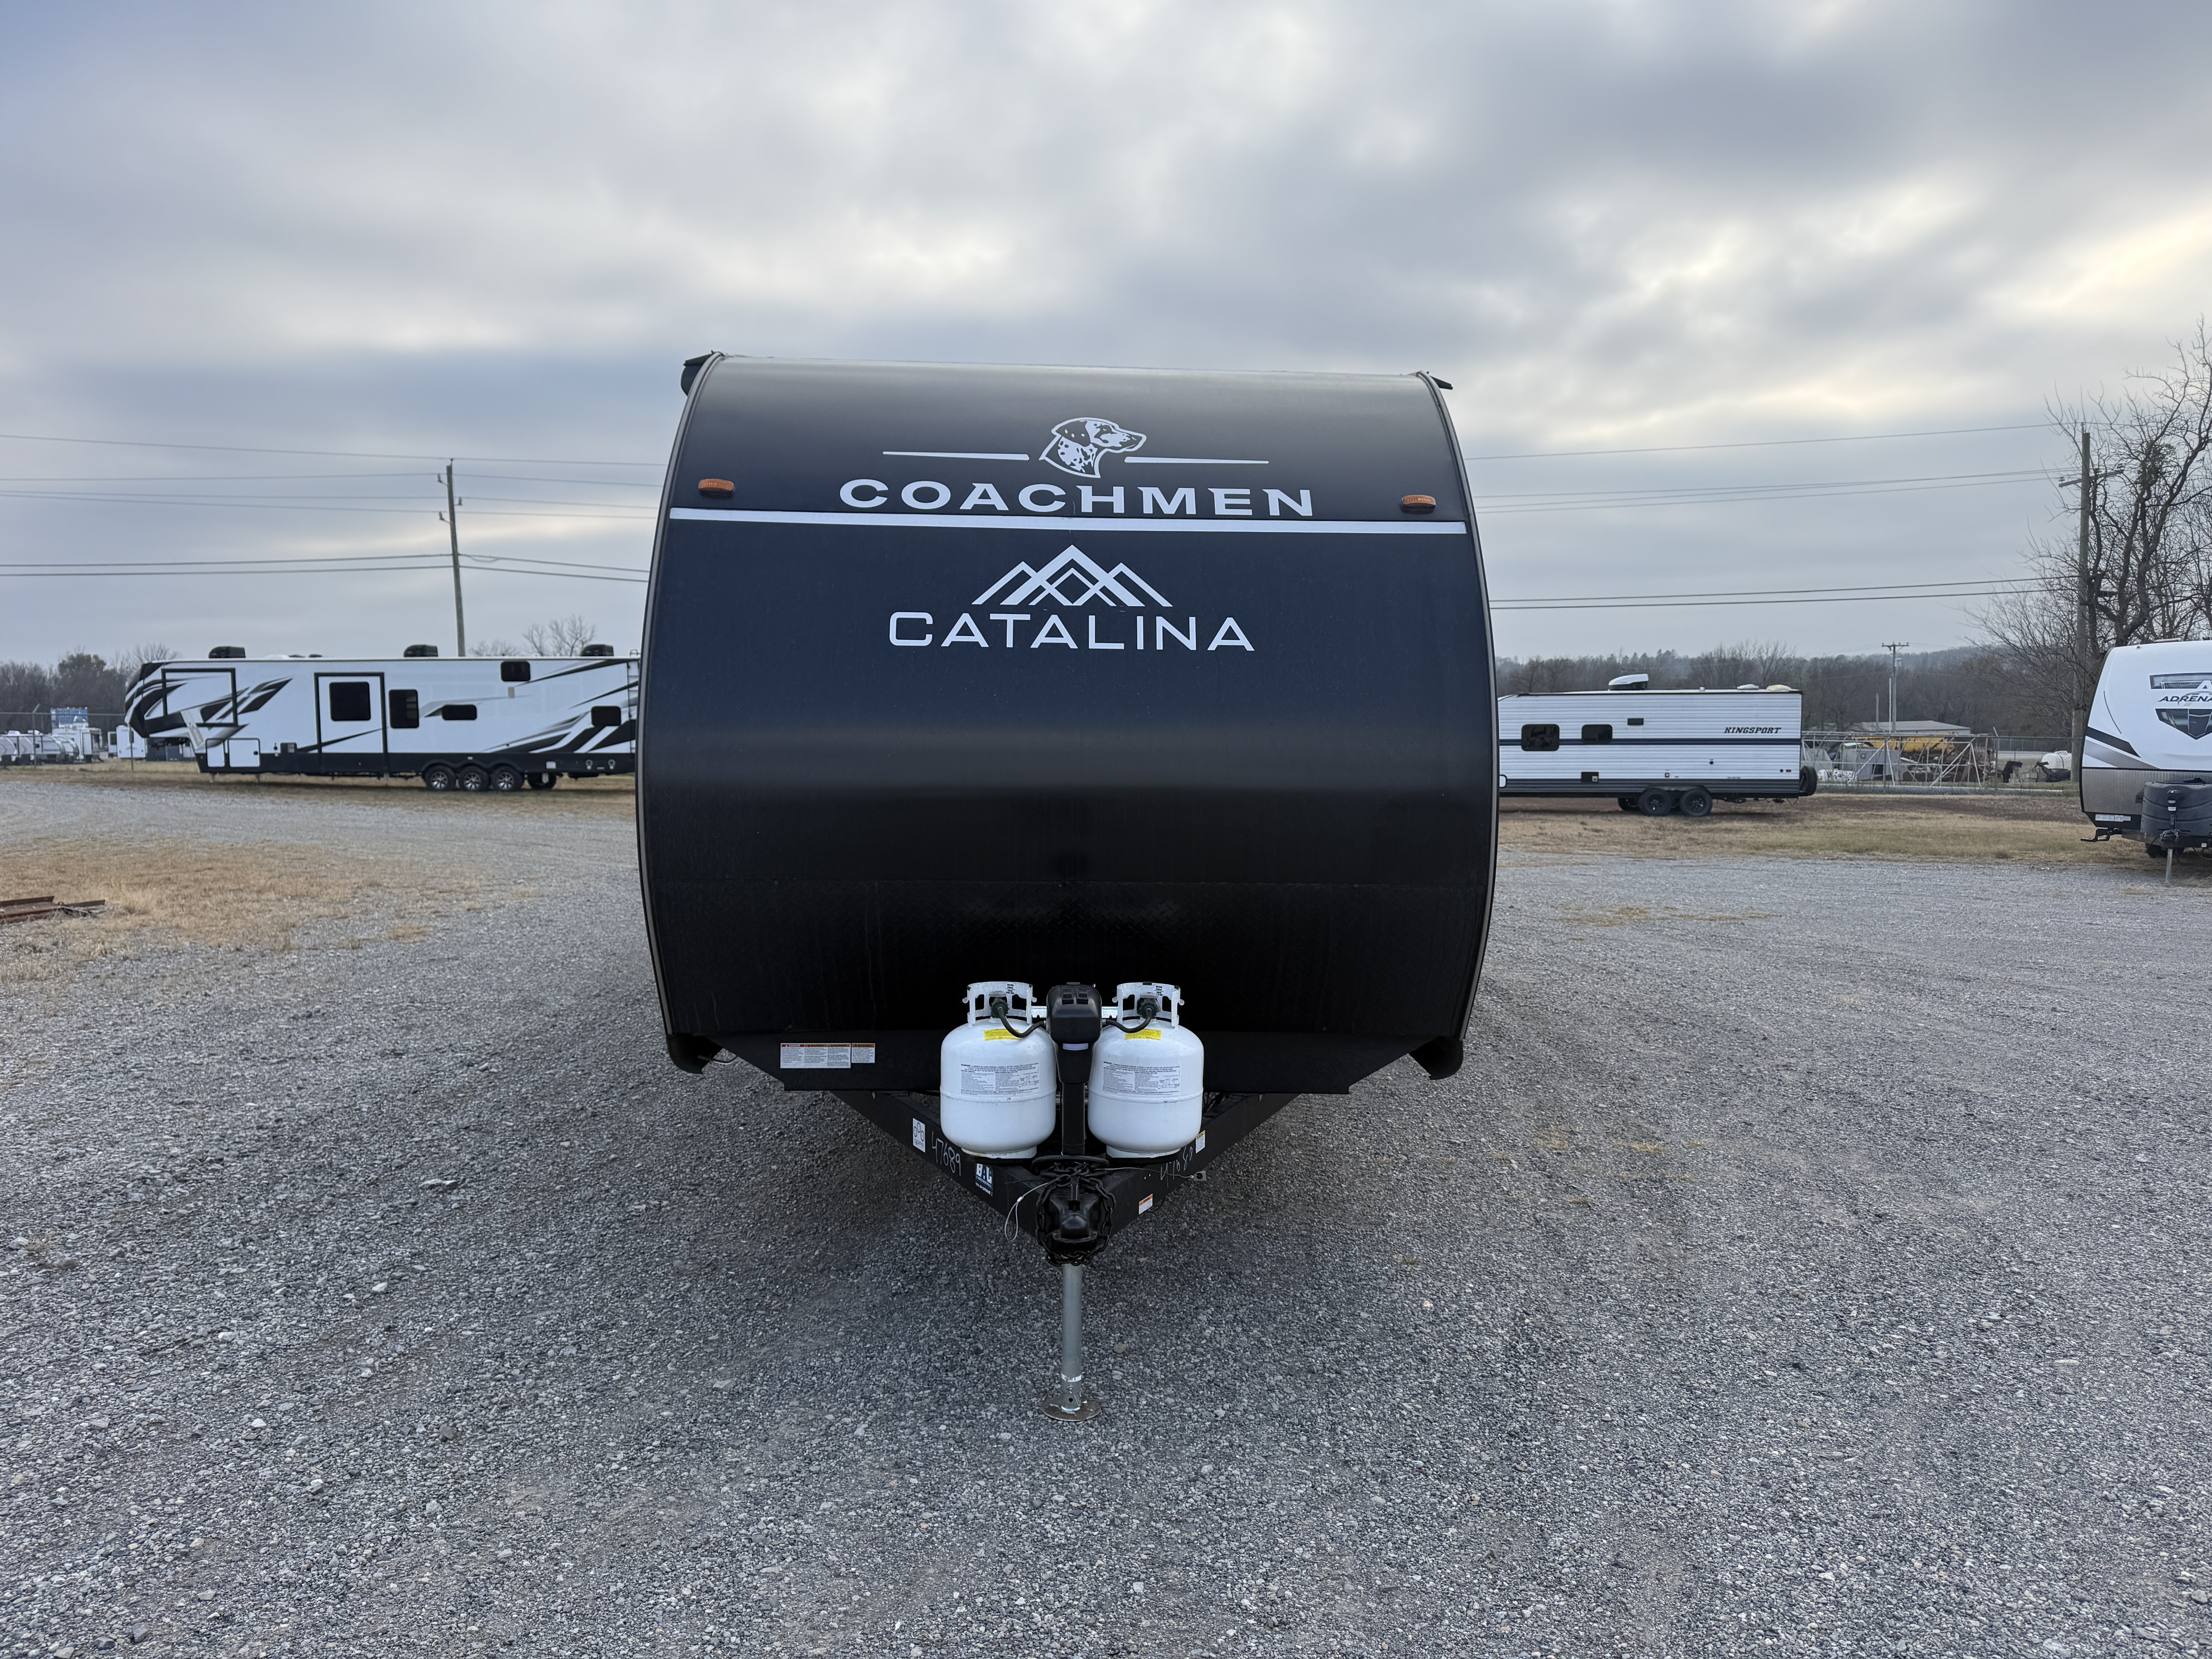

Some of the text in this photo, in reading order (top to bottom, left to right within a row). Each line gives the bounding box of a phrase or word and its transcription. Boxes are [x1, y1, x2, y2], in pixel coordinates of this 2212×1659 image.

[840, 479, 1313, 517] COACHMEN
[889, 612, 1255, 651] CATALINA
[932, 1130, 961, 1176] 47689
